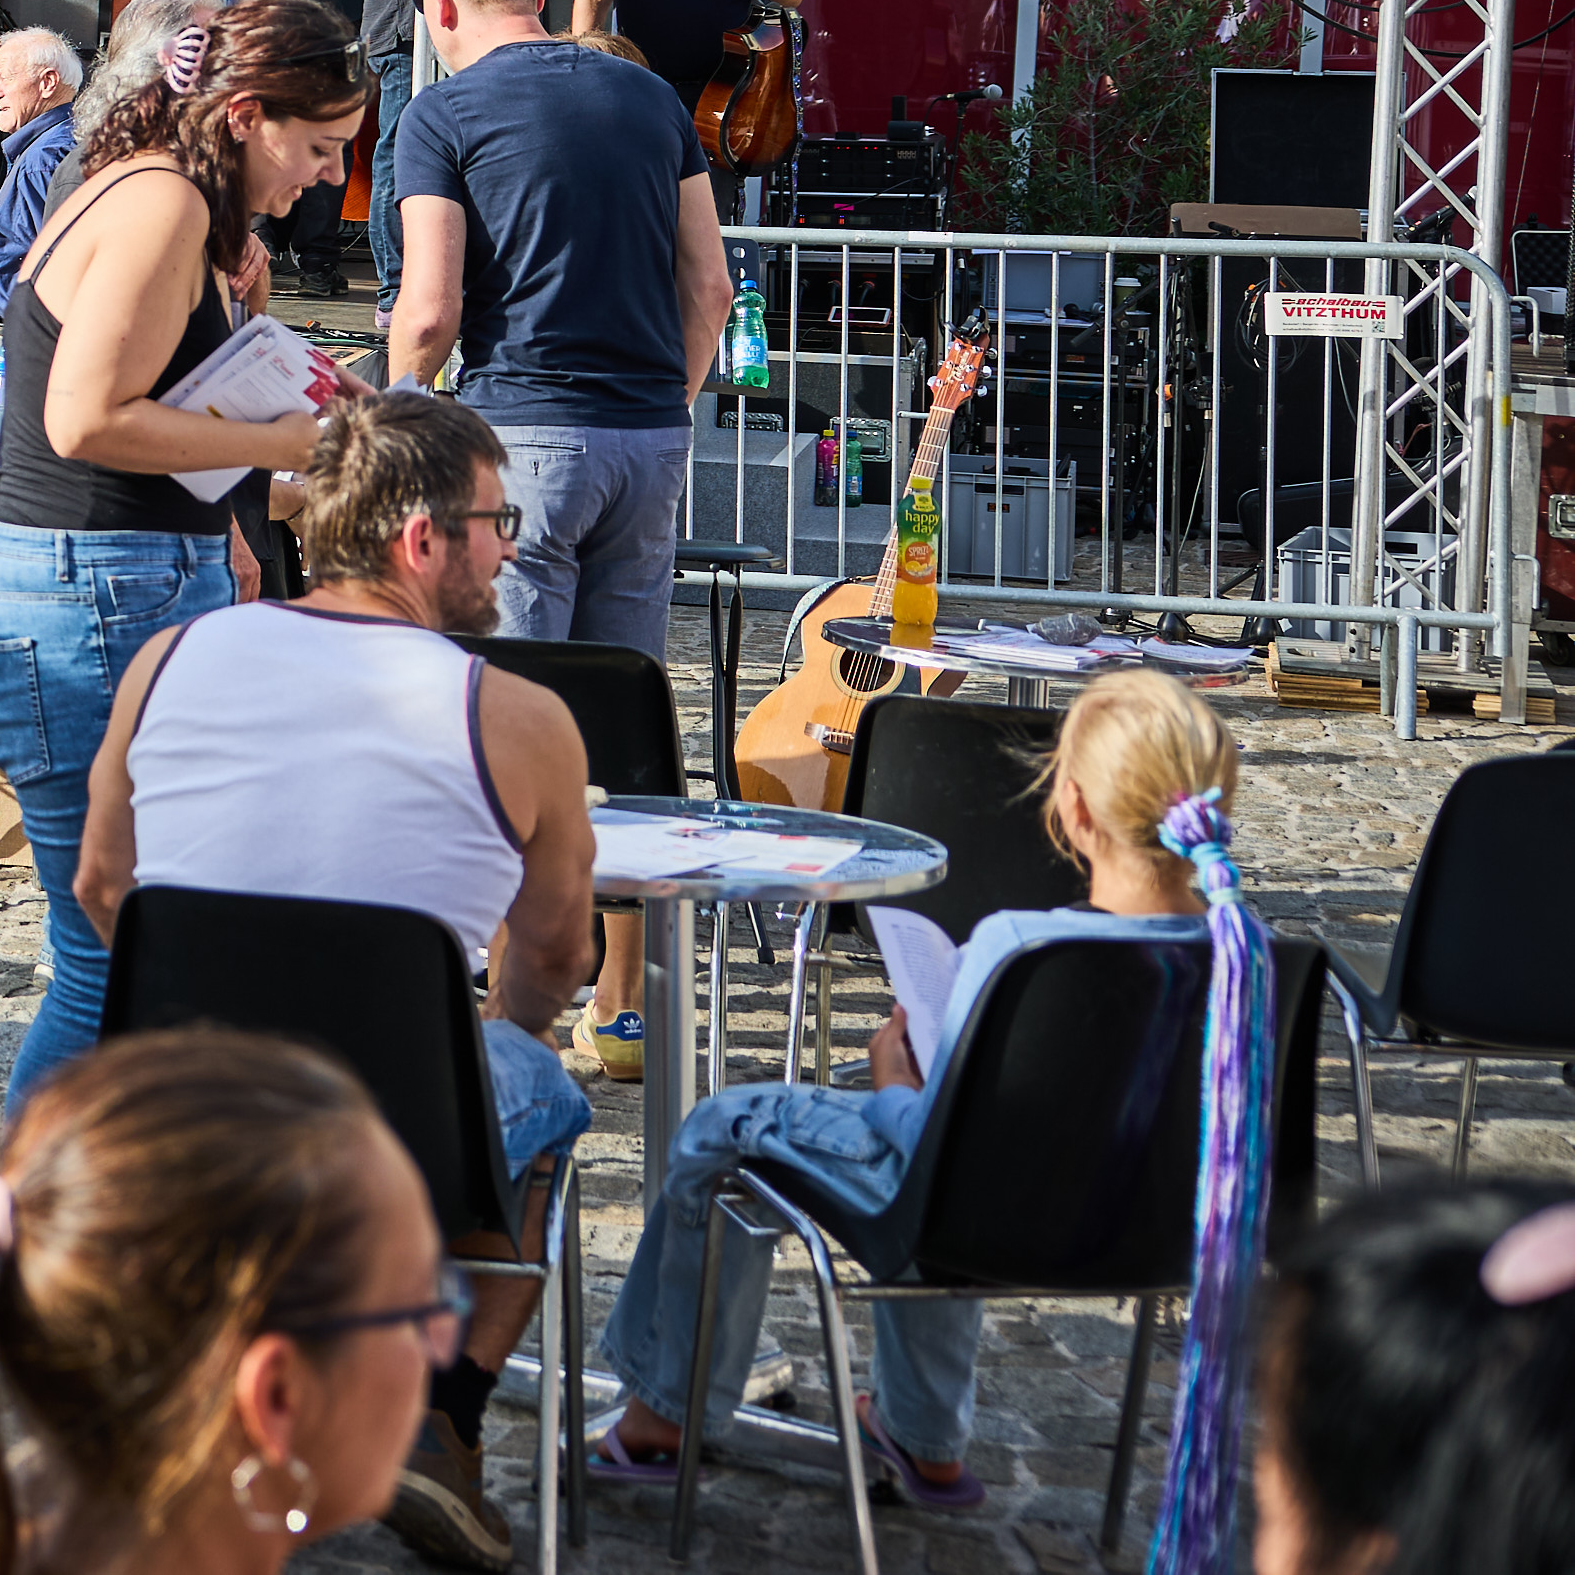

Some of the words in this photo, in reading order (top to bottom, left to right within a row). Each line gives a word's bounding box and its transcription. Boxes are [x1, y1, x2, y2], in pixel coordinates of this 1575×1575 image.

[1282, 307, 1386, 320] VITZTHUM
[905, 509, 940, 526] happy
[912, 522, 935, 536] day
